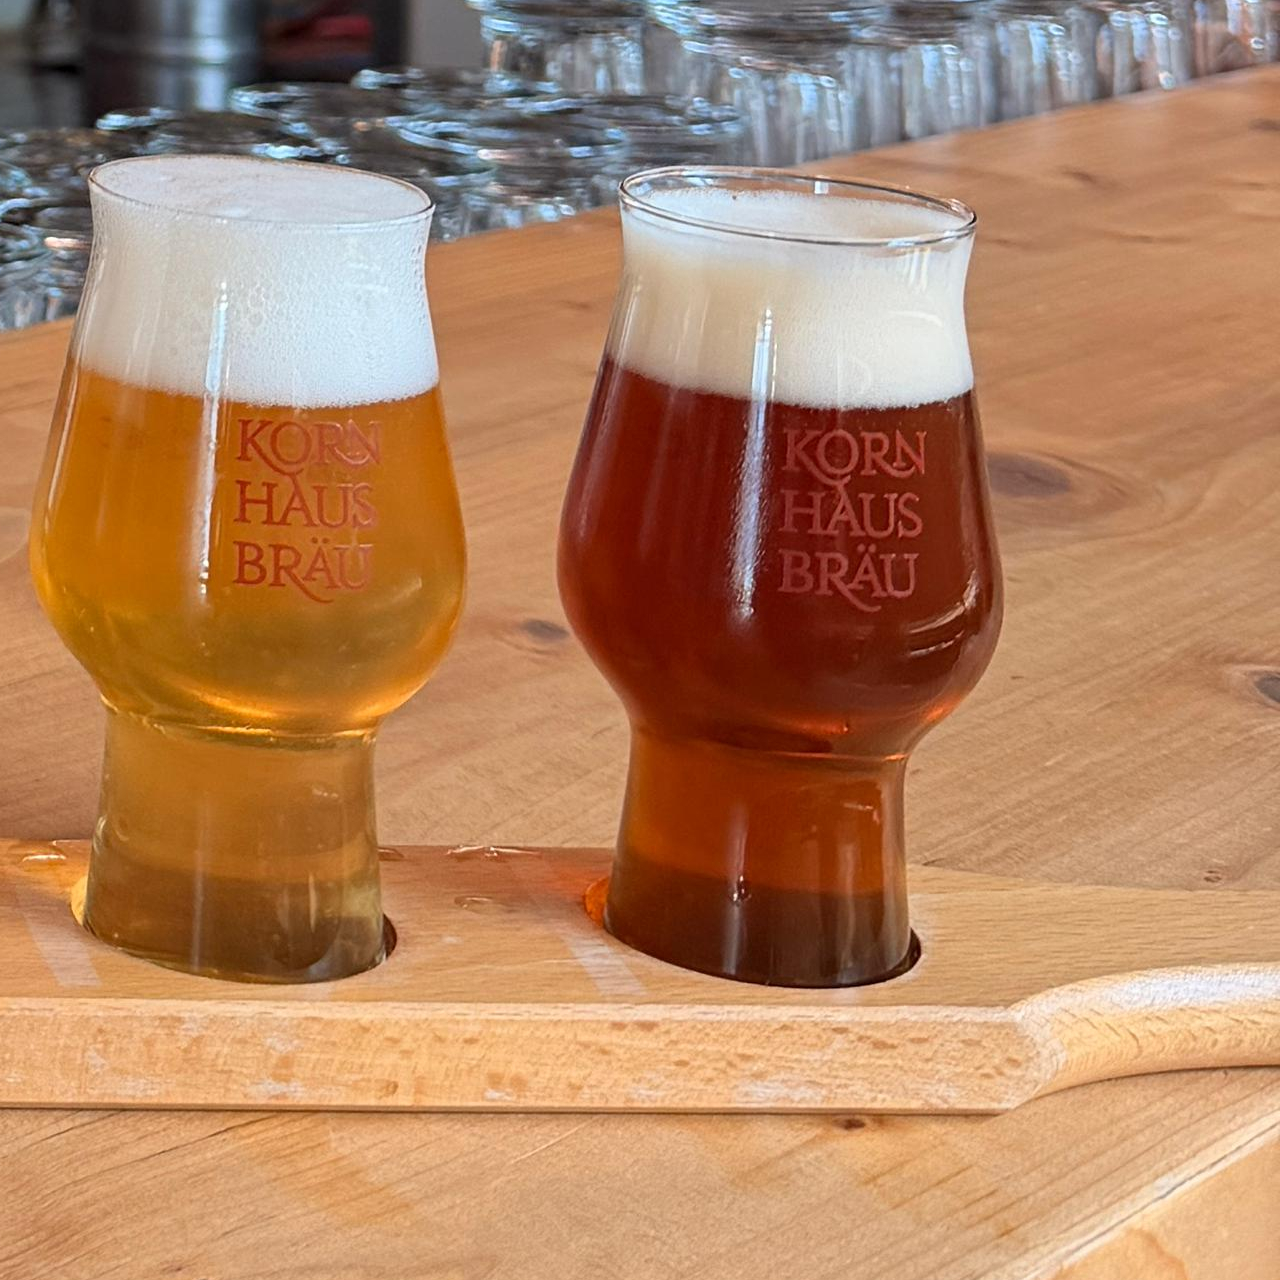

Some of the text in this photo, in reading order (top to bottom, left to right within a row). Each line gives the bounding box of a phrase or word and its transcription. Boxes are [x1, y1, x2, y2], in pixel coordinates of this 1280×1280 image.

[236, 418, 383, 475] KORN
[781, 427, 927, 486] KORN
[234, 473, 378, 529] HAUS
[778, 483, 924, 538] HAUS
[232, 537, 374, 604] BRÄU
[778, 544, 920, 612] BRÄU
